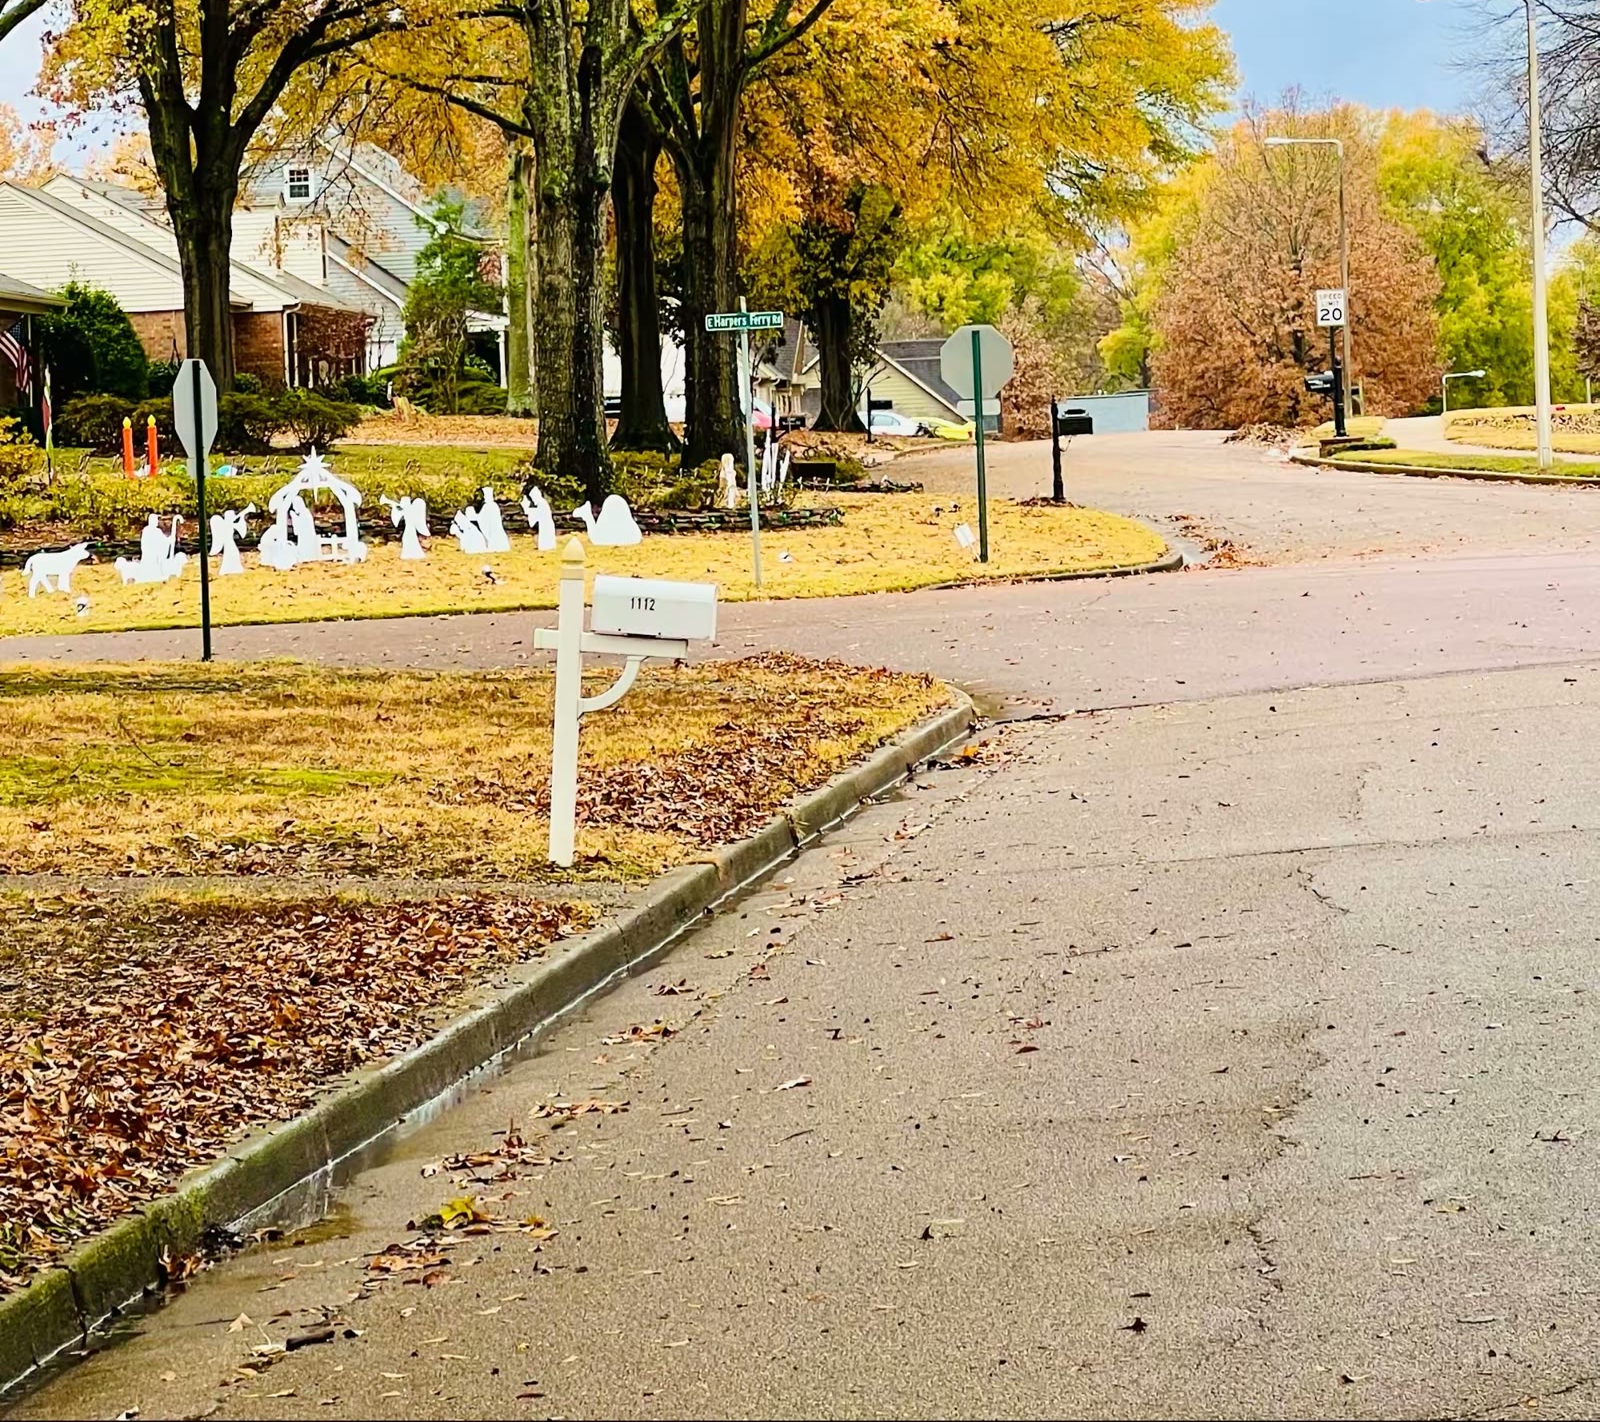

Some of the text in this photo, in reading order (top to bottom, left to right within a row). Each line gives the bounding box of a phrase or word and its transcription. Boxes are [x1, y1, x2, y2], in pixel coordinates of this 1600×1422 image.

[708, 314, 781, 328] E Harpers Ferry Rd
[1320, 308, 1342, 321] 20
[631, 597, 655, 611] 1112
